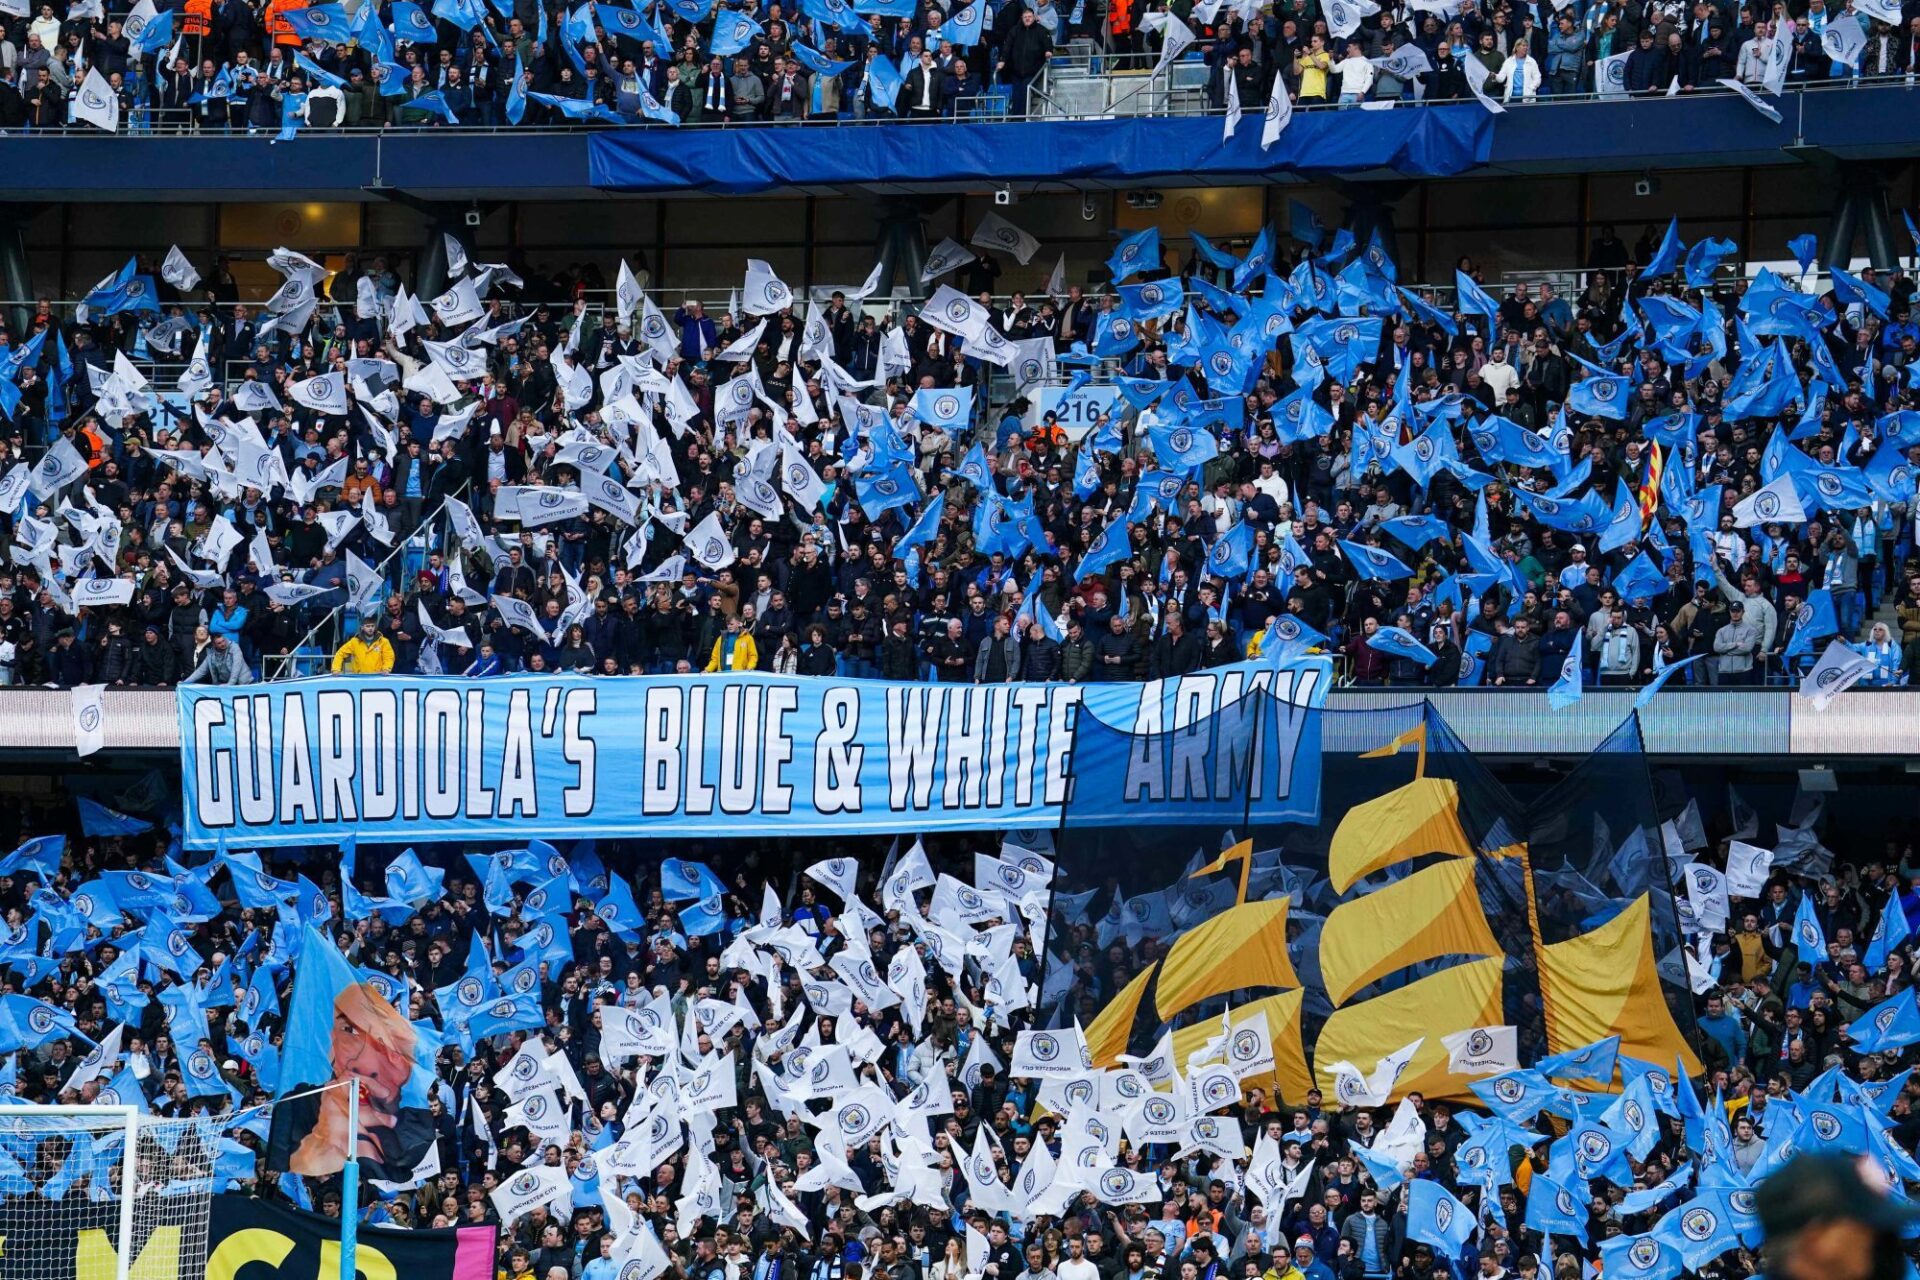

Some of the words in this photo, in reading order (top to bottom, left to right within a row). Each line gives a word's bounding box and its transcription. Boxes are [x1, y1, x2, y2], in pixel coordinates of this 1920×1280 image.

[930, 314, 958, 332] MANCHESTER
[1056, 399, 1100, 423] 216
[532, 509, 566, 521] MANCHESTER
[592, 496, 622, 511] MANCHESTER
[621, 508, 632, 517] CITY
[194, 686, 597, 827] GUARDIOLA'S
[642, 684, 799, 816] BLUE
[813, 686, 865, 816] &
[886, 685, 1086, 811] WHITE
[1124, 669, 1320, 803] ARMY
[724, 1011, 735, 1023] CITY
[508, 1192, 544, 1214] MANCHESTER
[544, 1185, 557, 1195] CITY
